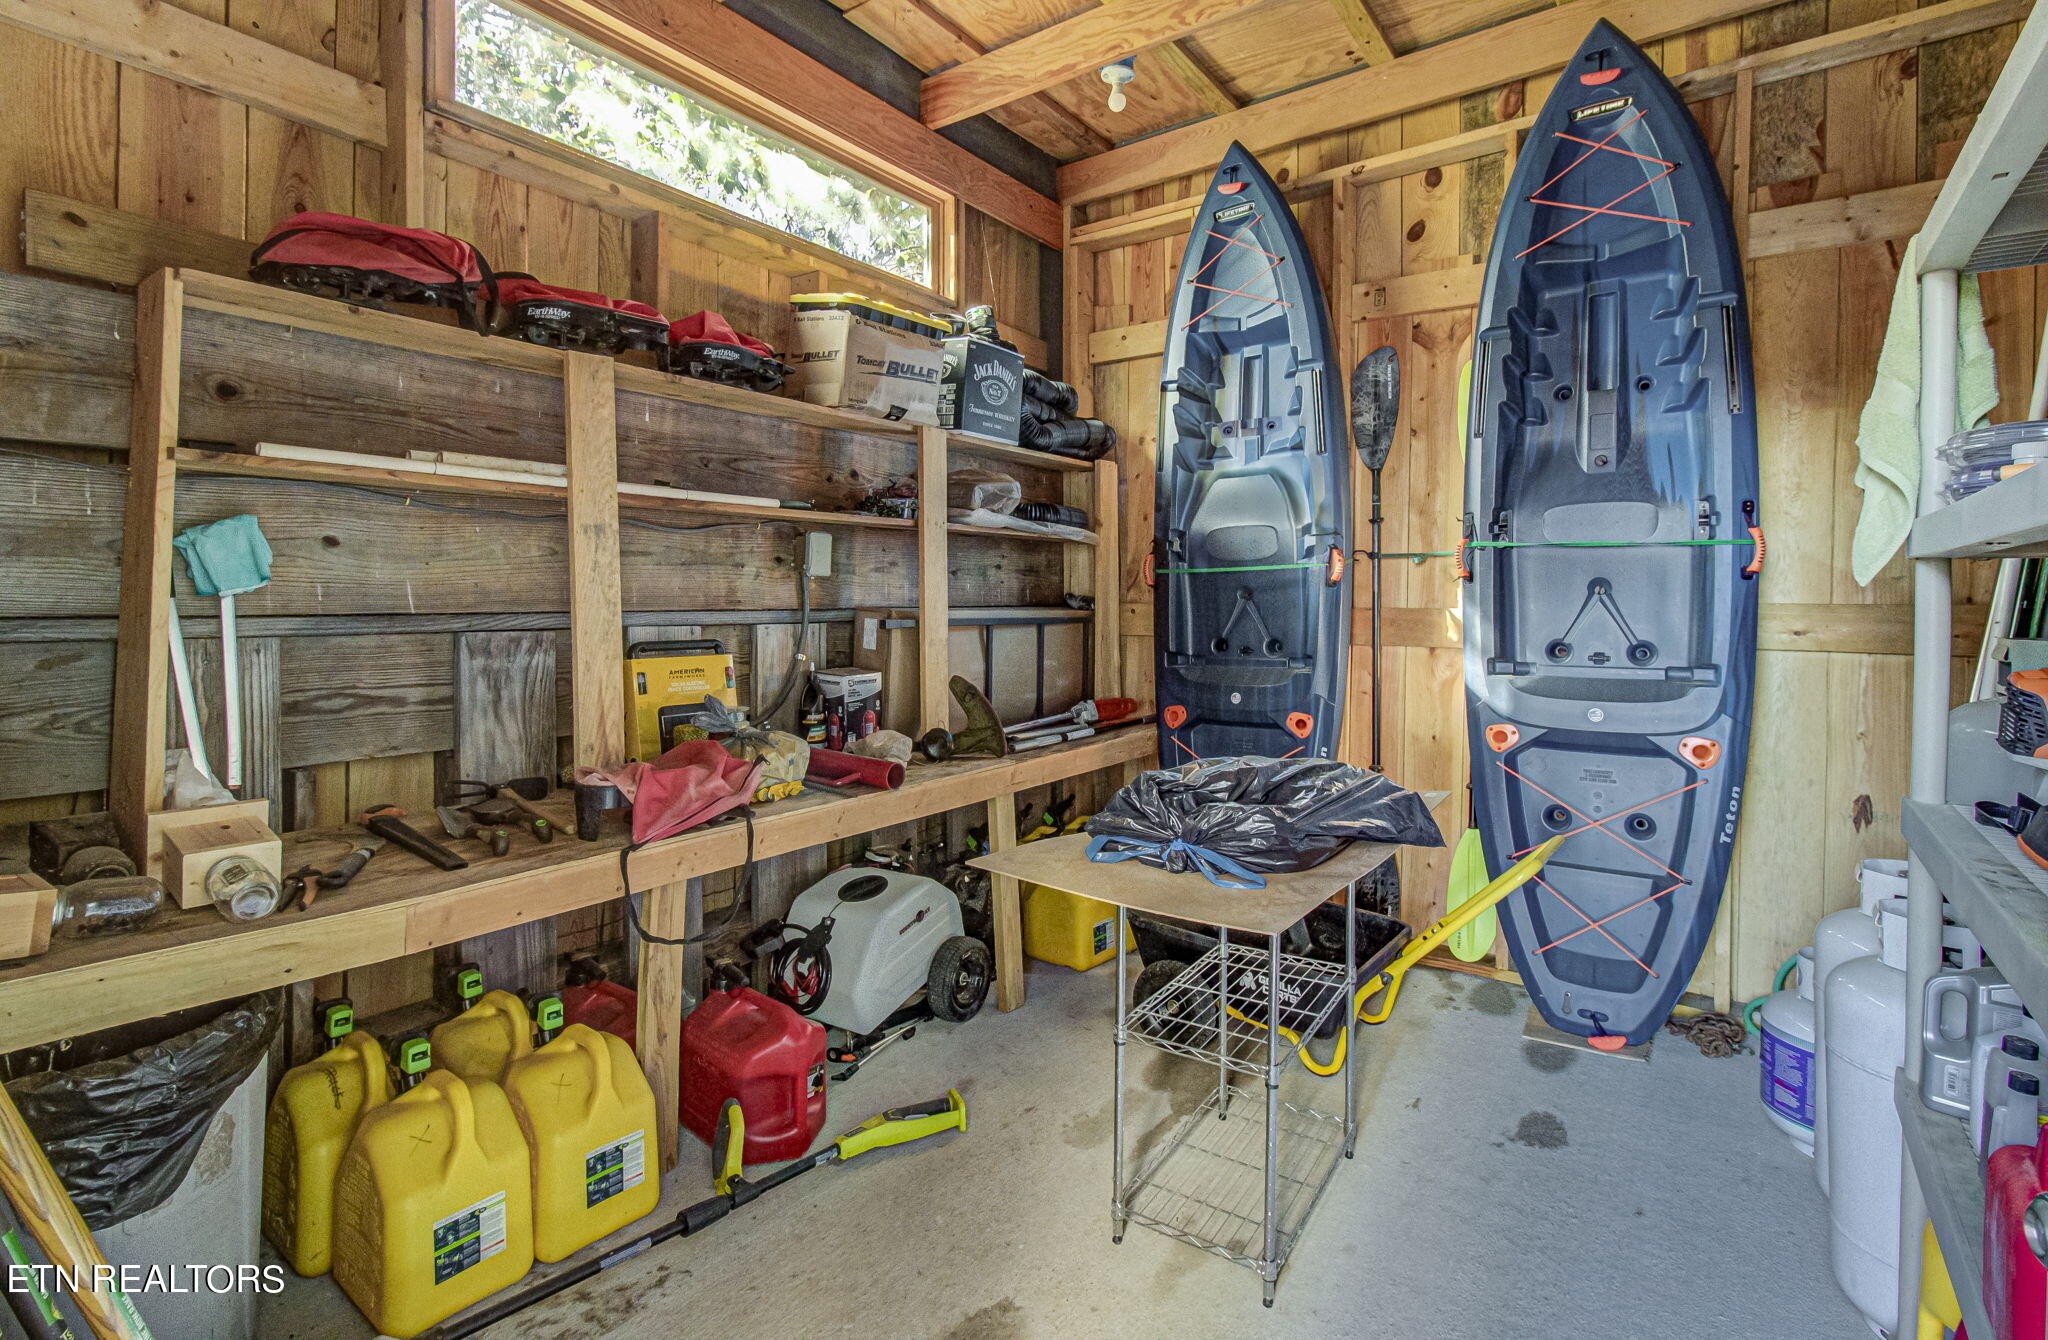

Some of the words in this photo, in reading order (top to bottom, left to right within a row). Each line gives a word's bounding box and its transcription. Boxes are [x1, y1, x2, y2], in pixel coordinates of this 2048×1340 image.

[885, 360, 940, 381] BULLET
[974, 360, 993, 381] JACK
[668, 667, 705, 676] AMERICAN
[1719, 786, 1741, 844] Teton
